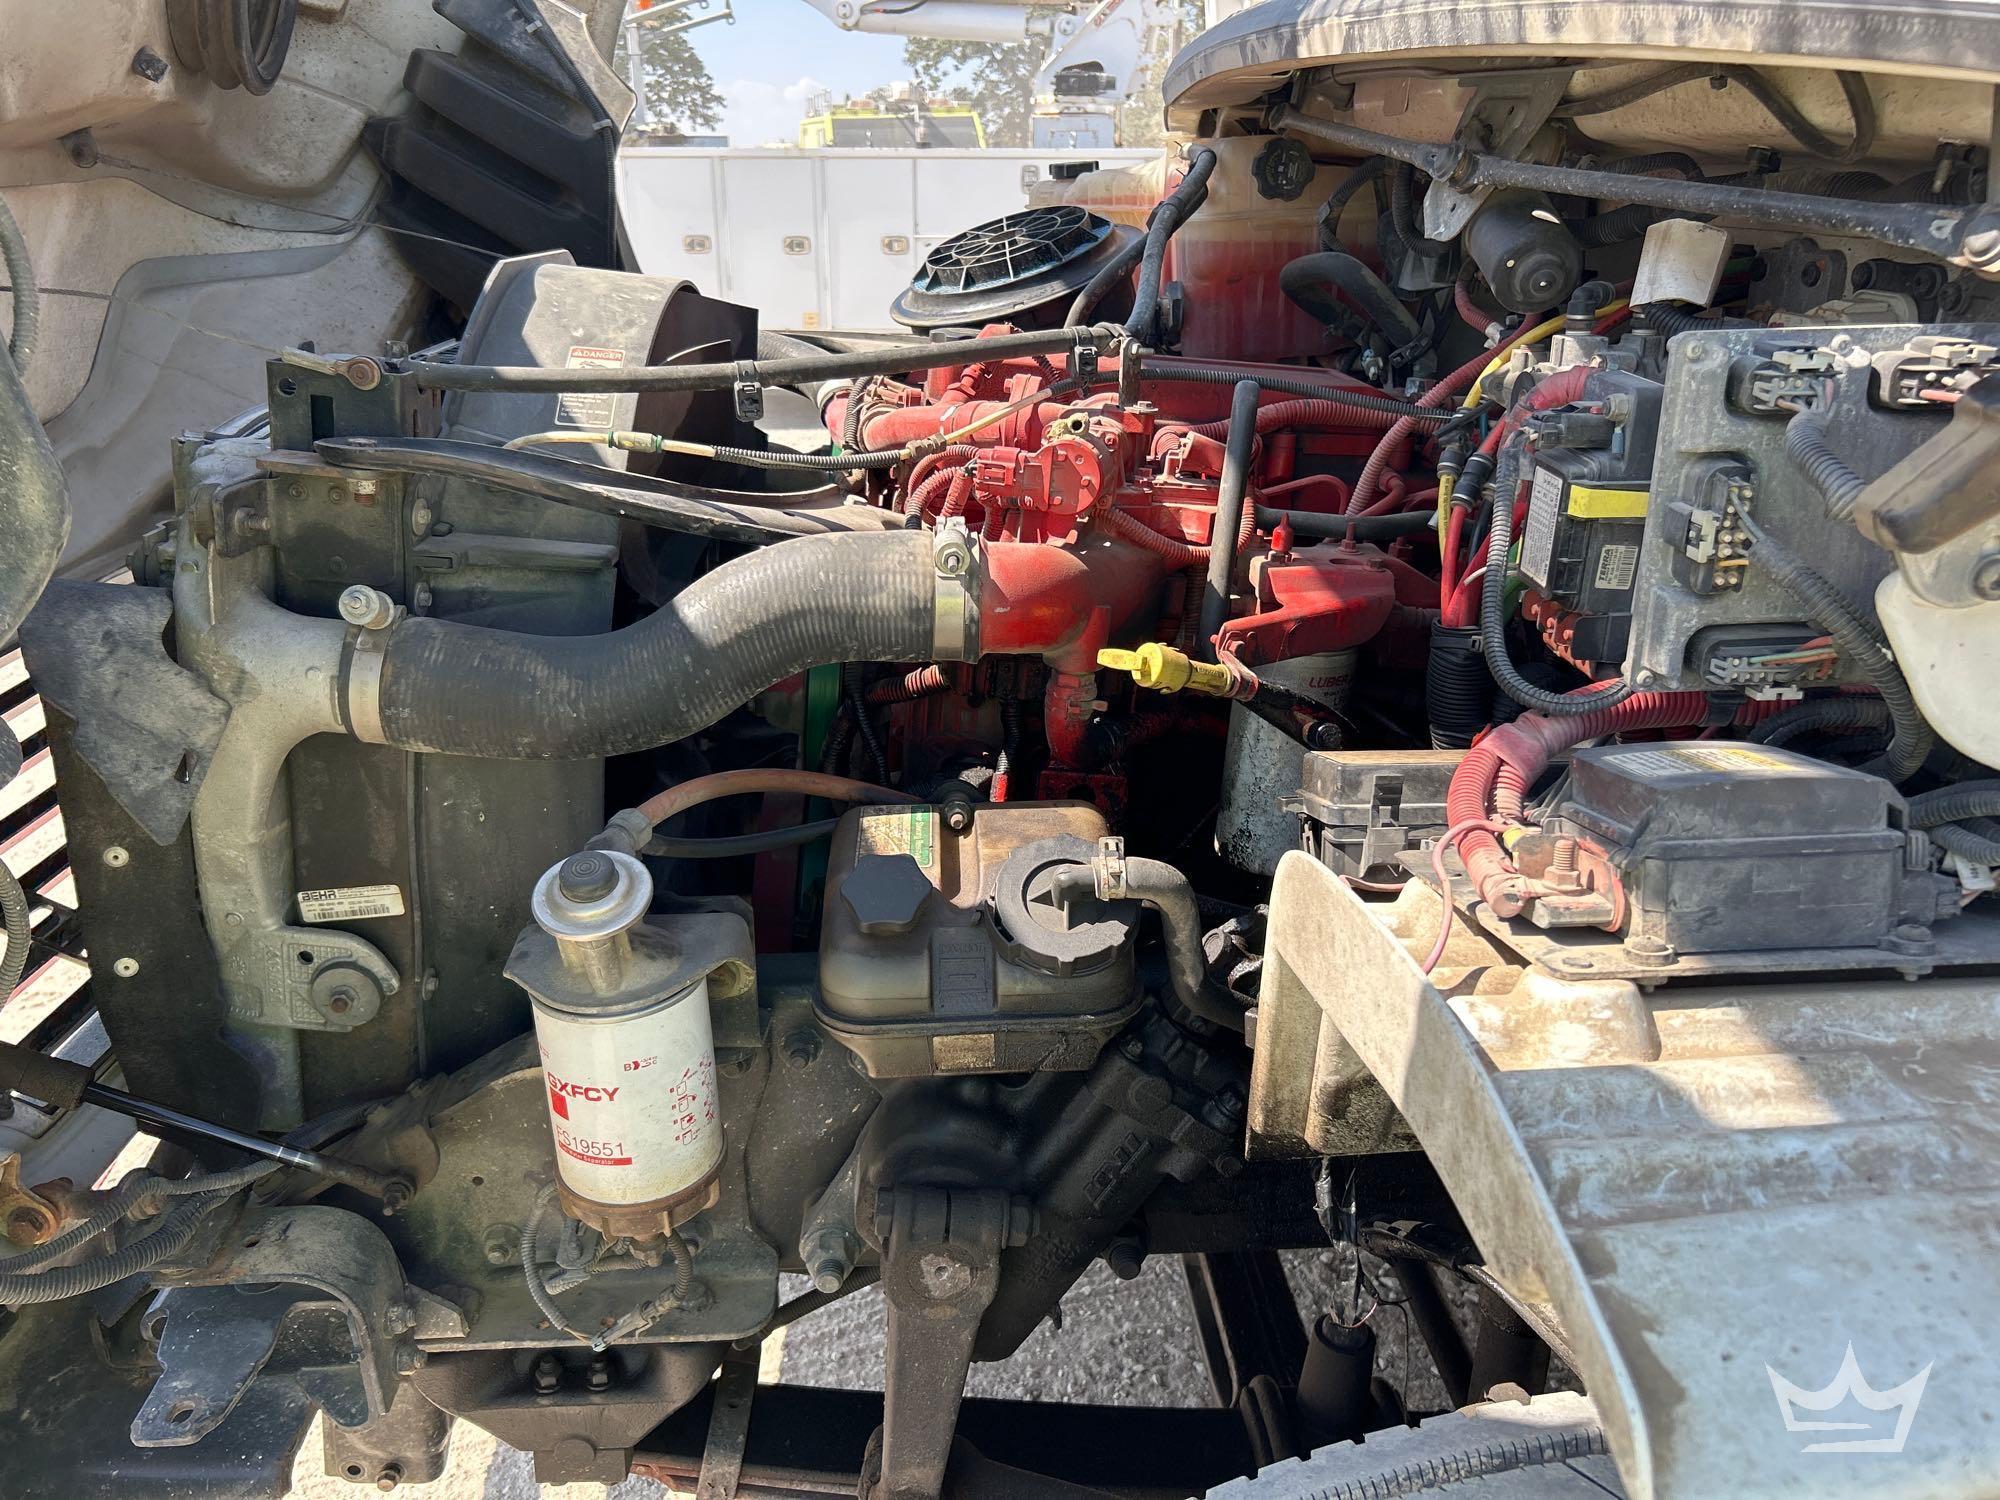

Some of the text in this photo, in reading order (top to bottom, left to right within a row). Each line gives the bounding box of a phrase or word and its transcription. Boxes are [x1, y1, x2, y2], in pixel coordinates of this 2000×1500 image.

[582, 351, 622, 360] DANGER
[1598, 548, 1614, 581] TERRA
[301, 890, 337, 901] BEHR
[547, 1071, 620, 1102] GXFCY
[556, 1125, 624, 1156] FS19551
